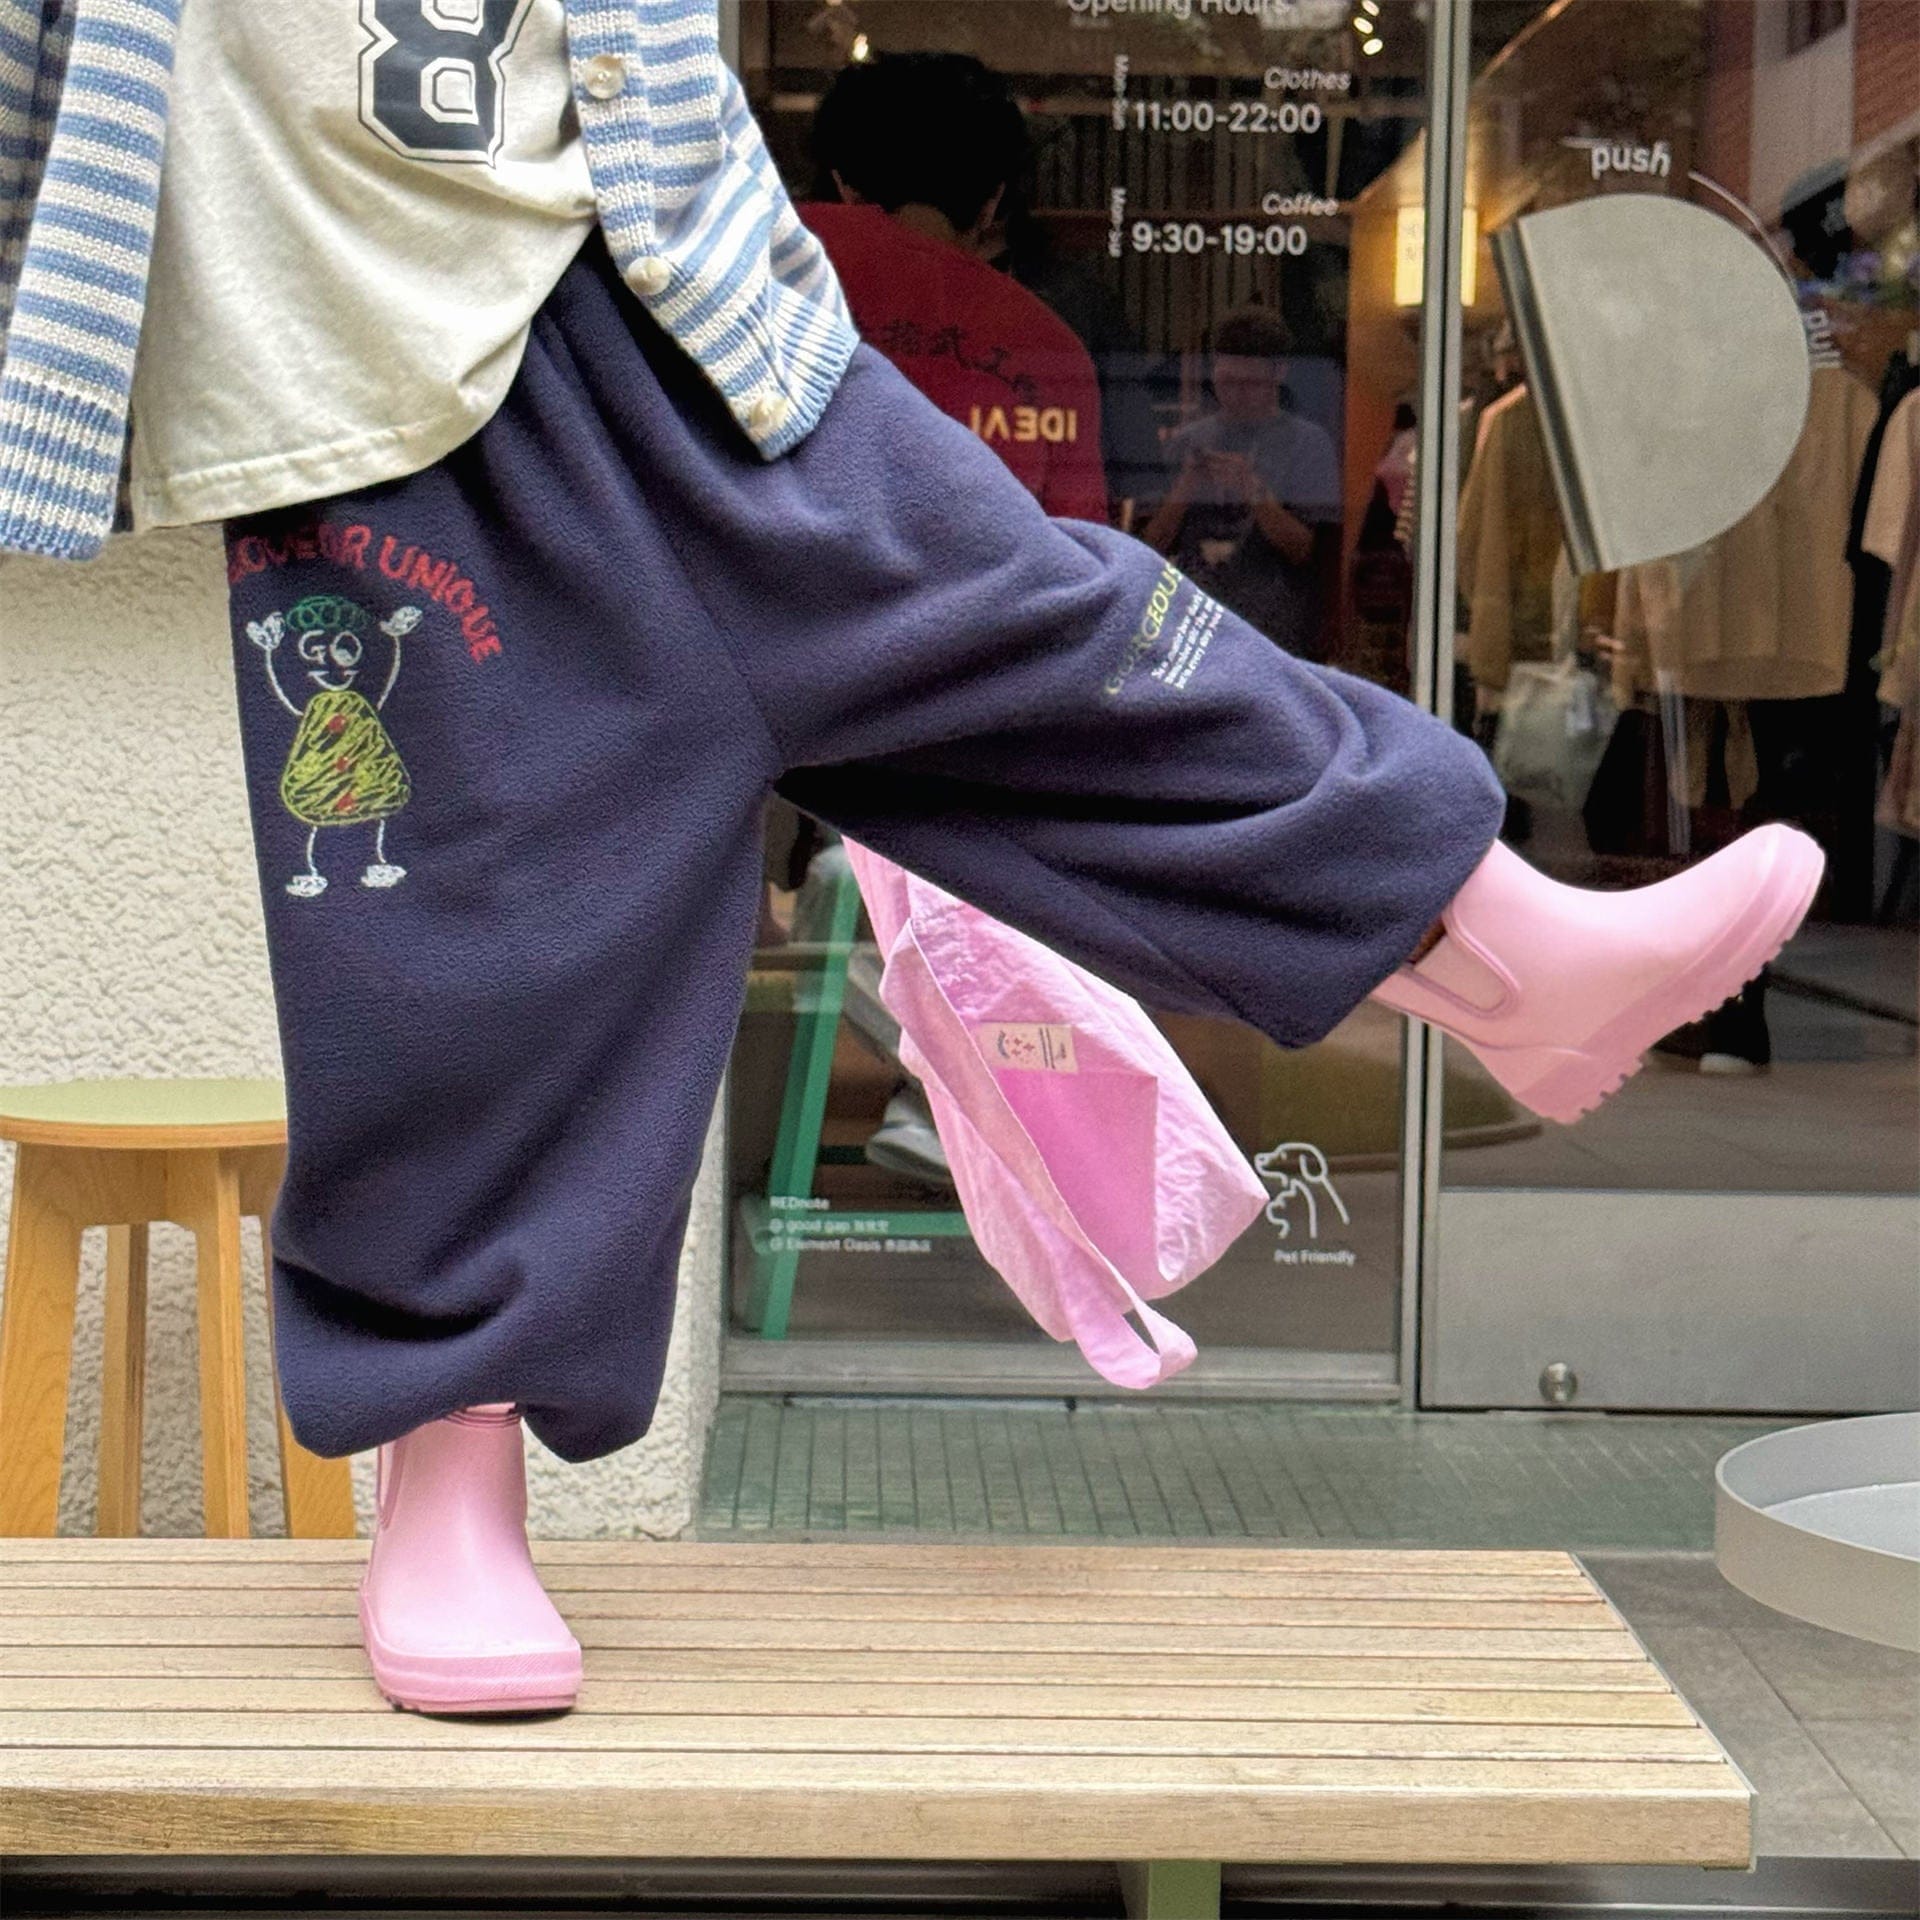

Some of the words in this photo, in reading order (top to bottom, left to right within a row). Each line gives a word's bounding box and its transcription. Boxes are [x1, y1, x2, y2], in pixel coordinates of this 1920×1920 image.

[1263, 66, 1351, 91] Clothes
[1133, 101, 1322, 133] 11:00-22:00
[1591, 140, 1672, 181] push
[1261, 193, 1339, 217] Coffee
[1131, 221, 1308, 256] 9:30-19:00
[1803, 309, 1843, 369] pull
[378, 534, 503, 666] UNIQUE
[1300, 1249, 1356, 1267] Friendly
